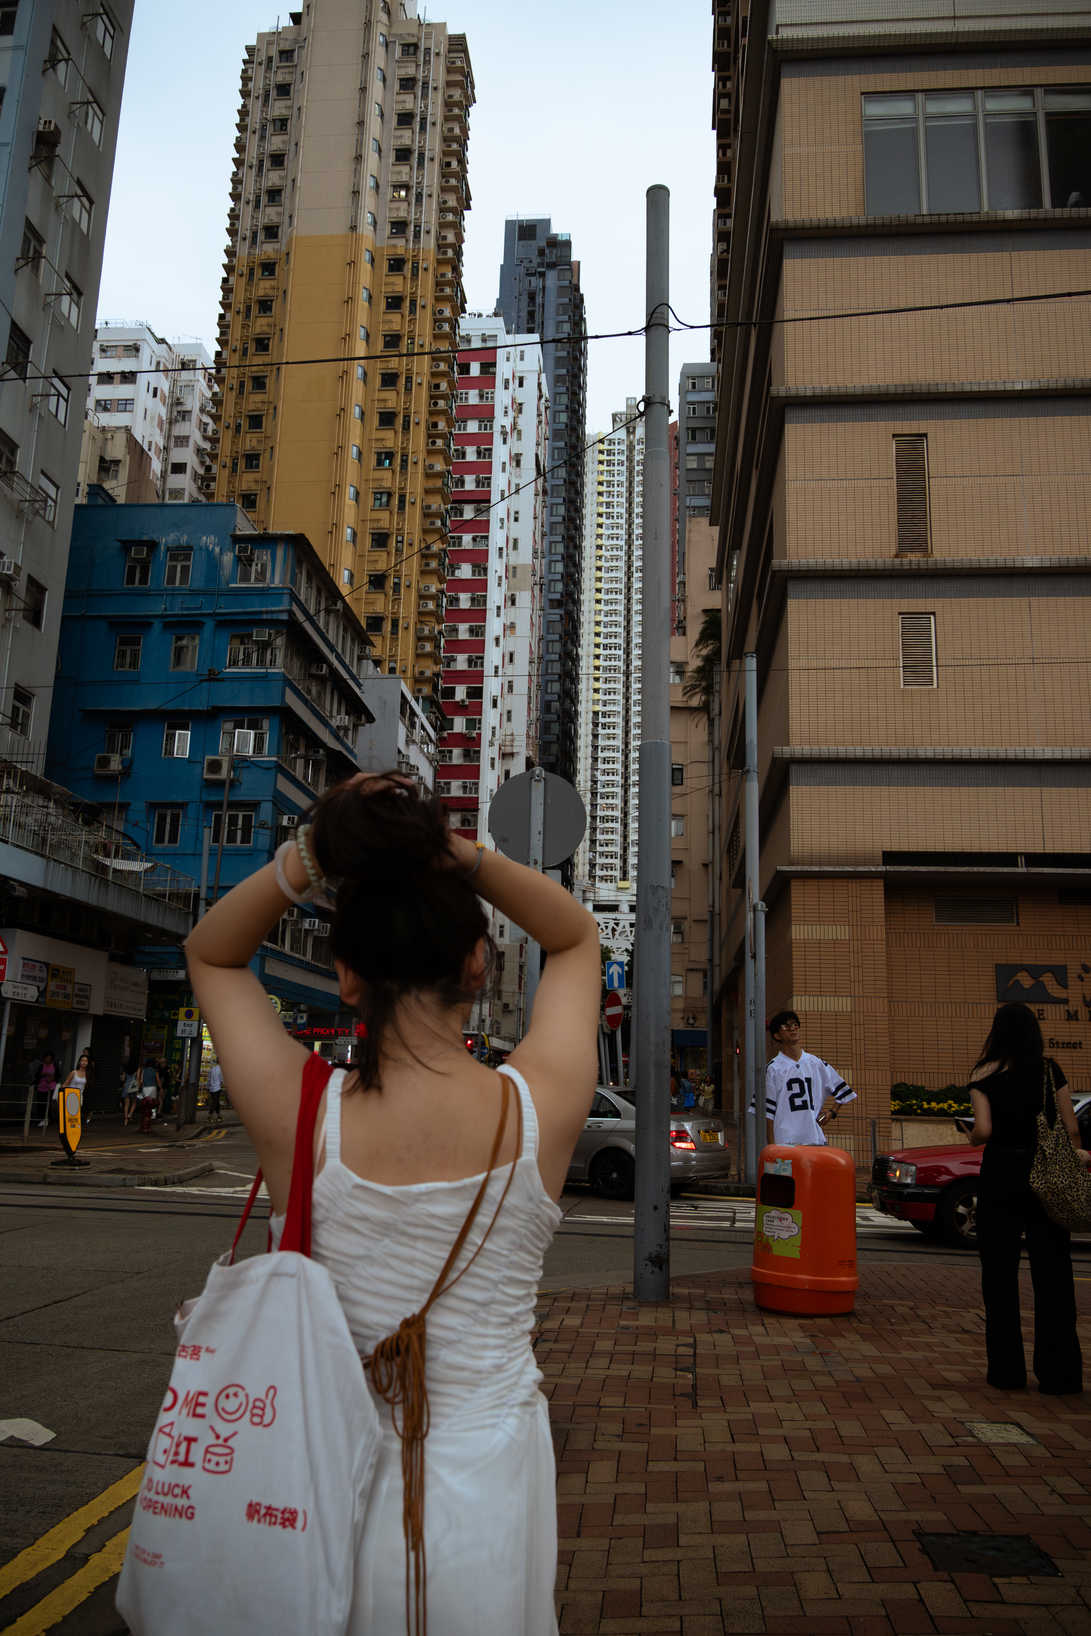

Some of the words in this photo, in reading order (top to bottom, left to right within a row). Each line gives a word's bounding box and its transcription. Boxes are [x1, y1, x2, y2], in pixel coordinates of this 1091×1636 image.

[1048, 1038, 1082, 1049] Street
[786, 1077, 815, 1112] 21
[154, 1480, 192, 1500] LUCK
